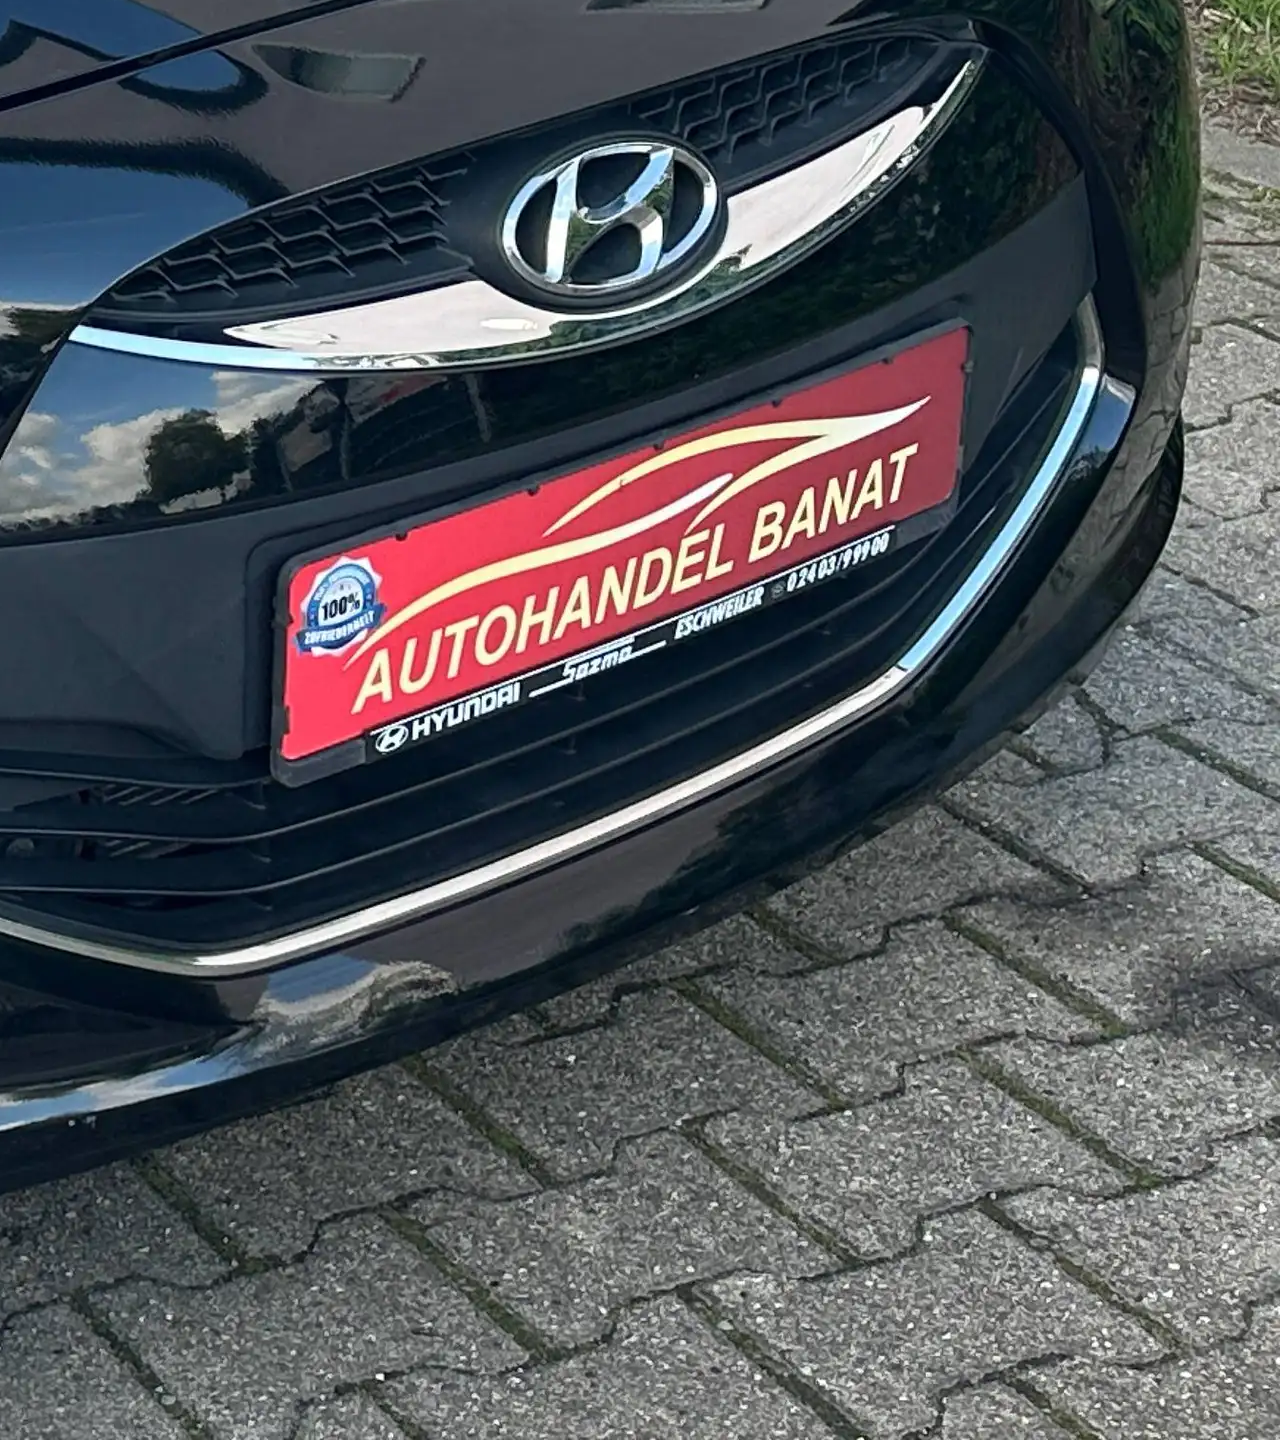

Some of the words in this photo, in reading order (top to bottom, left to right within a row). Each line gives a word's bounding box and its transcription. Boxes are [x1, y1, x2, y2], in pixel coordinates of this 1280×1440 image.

[321, 591, 361, 621] 100%
[351, 523, 734, 714] AUTOHANDEL
[748, 443, 918, 563] BANAT
[411, 682, 521, 741] HYUNDAI
[674, 586, 765, 640] ESCHWEILER
